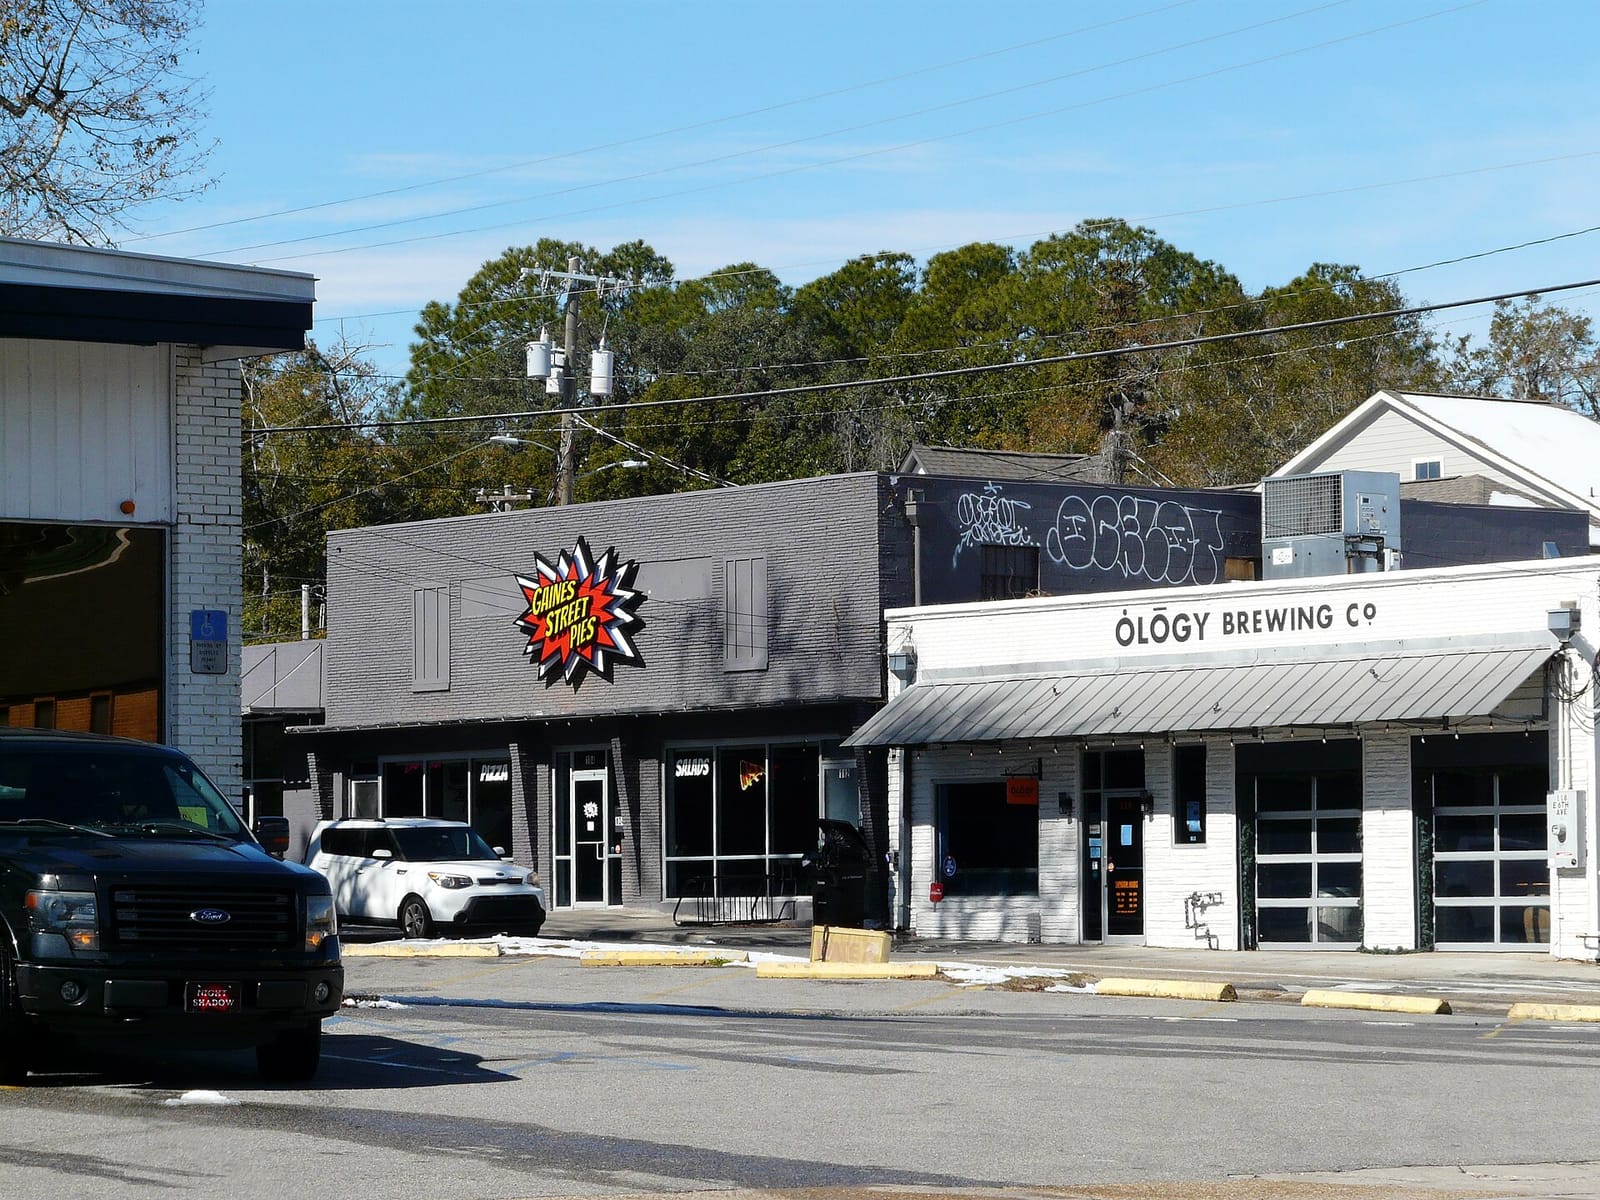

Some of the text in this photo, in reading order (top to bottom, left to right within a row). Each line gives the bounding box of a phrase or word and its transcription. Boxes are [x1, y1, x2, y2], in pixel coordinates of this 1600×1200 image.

[532, 580, 577, 616] GAINES
[545, 597, 590, 637] STREET
[1222, 604, 1334, 635] BREWING
[570, 616, 597, 649] PIES
[480, 764, 508, 781] PIZZA
[675, 758, 710, 777] SALADS
[201, 910, 223, 921] Ford
[193, 998, 235, 1007] SHADOW
[197, 989, 228, 997] NIGHT
